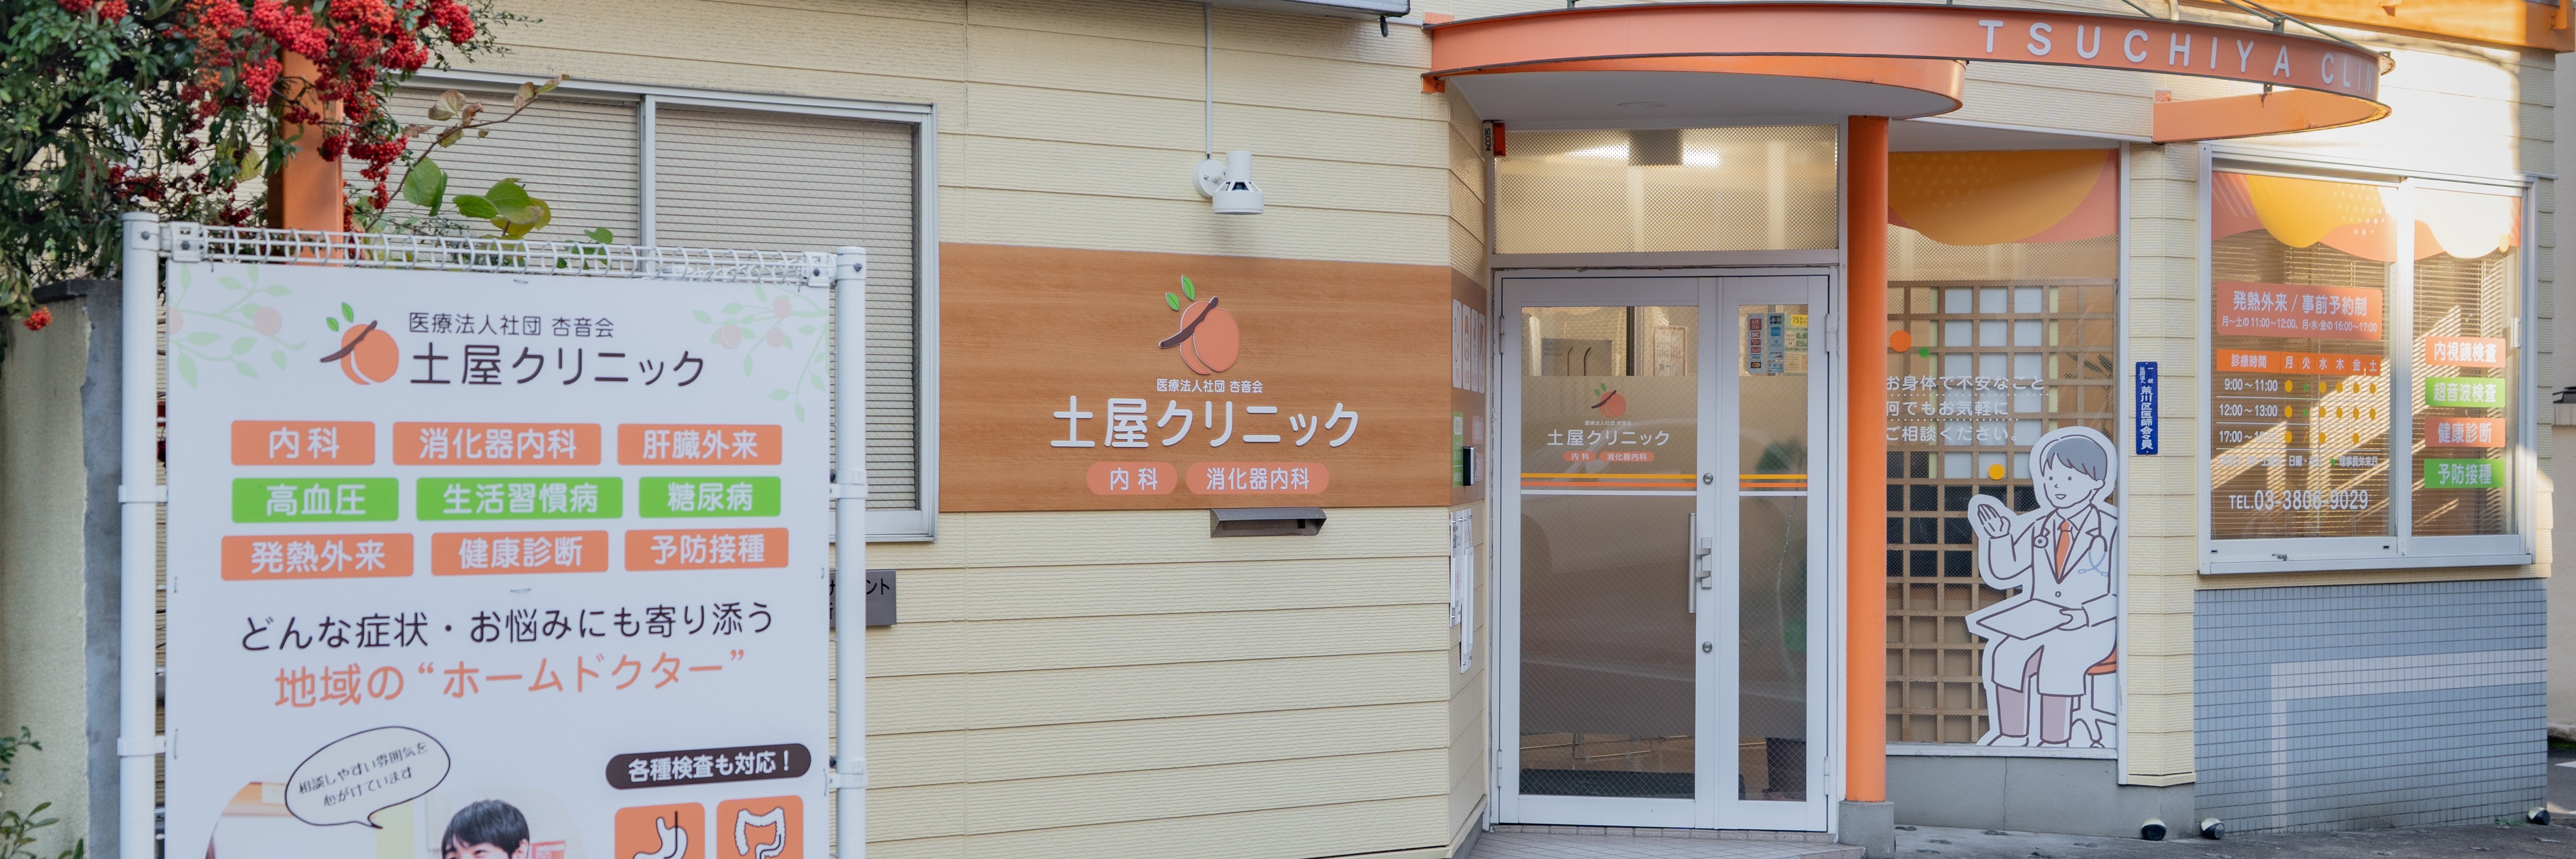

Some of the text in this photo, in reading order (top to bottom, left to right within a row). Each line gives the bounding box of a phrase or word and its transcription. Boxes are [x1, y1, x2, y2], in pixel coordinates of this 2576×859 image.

[1979, 20, 2291, 78] TSUCHIYA
[2233, 290, 2287, 312] 発熱外来
[2302, 294, 2367, 316] 事前予約制
[409, 312, 614, 338] 医療法人社団 杏音会
[410, 344, 705, 388] 土屋クリニック
[2231, 354, 2377, 372] 診療時間 月 火 水 木 金 土
[2434, 341, 2497, 363] 内視鏡検査
[1157, 379, 1263, 393] 医療法人社団 杏音会
[1887, 375, 2045, 391] お身体で不安なこと
[2434, 382, 2496, 402] 超音波検査
[1051, 395, 1358, 447] 土屋クリニック
[1887, 400, 2008, 416] 何でもお気軽に
[419, 428, 577, 460] 消化器内科
[642, 430, 758, 459] 肝臓外来
[1547, 429, 1669, 445] 土屋クリニック
[1887, 426, 2017, 442] ご相談ください。
[2438, 422, 2492, 443] 健康診断
[1206, 467, 1309, 490] 消化器内科
[2438, 464, 2492, 484] 予防接種
[266, 484, 366, 515] 高血圧
[443, 483, 597, 514] 生活習慣病
[667, 481, 753, 512] 糖尿病
[251, 540, 385, 574] 発熱外来
[459, 537, 583, 570] 健康診断
[651, 534, 764, 565] 予防接種
[241, 602, 774, 652] どんな症状・お悩みにも寄り添う
[299, 742, 427, 795] 相談しやすい雰囲気を
[628, 750, 789, 782] 各種検査も対応！
[324, 767, 412, 806] 心がけています
